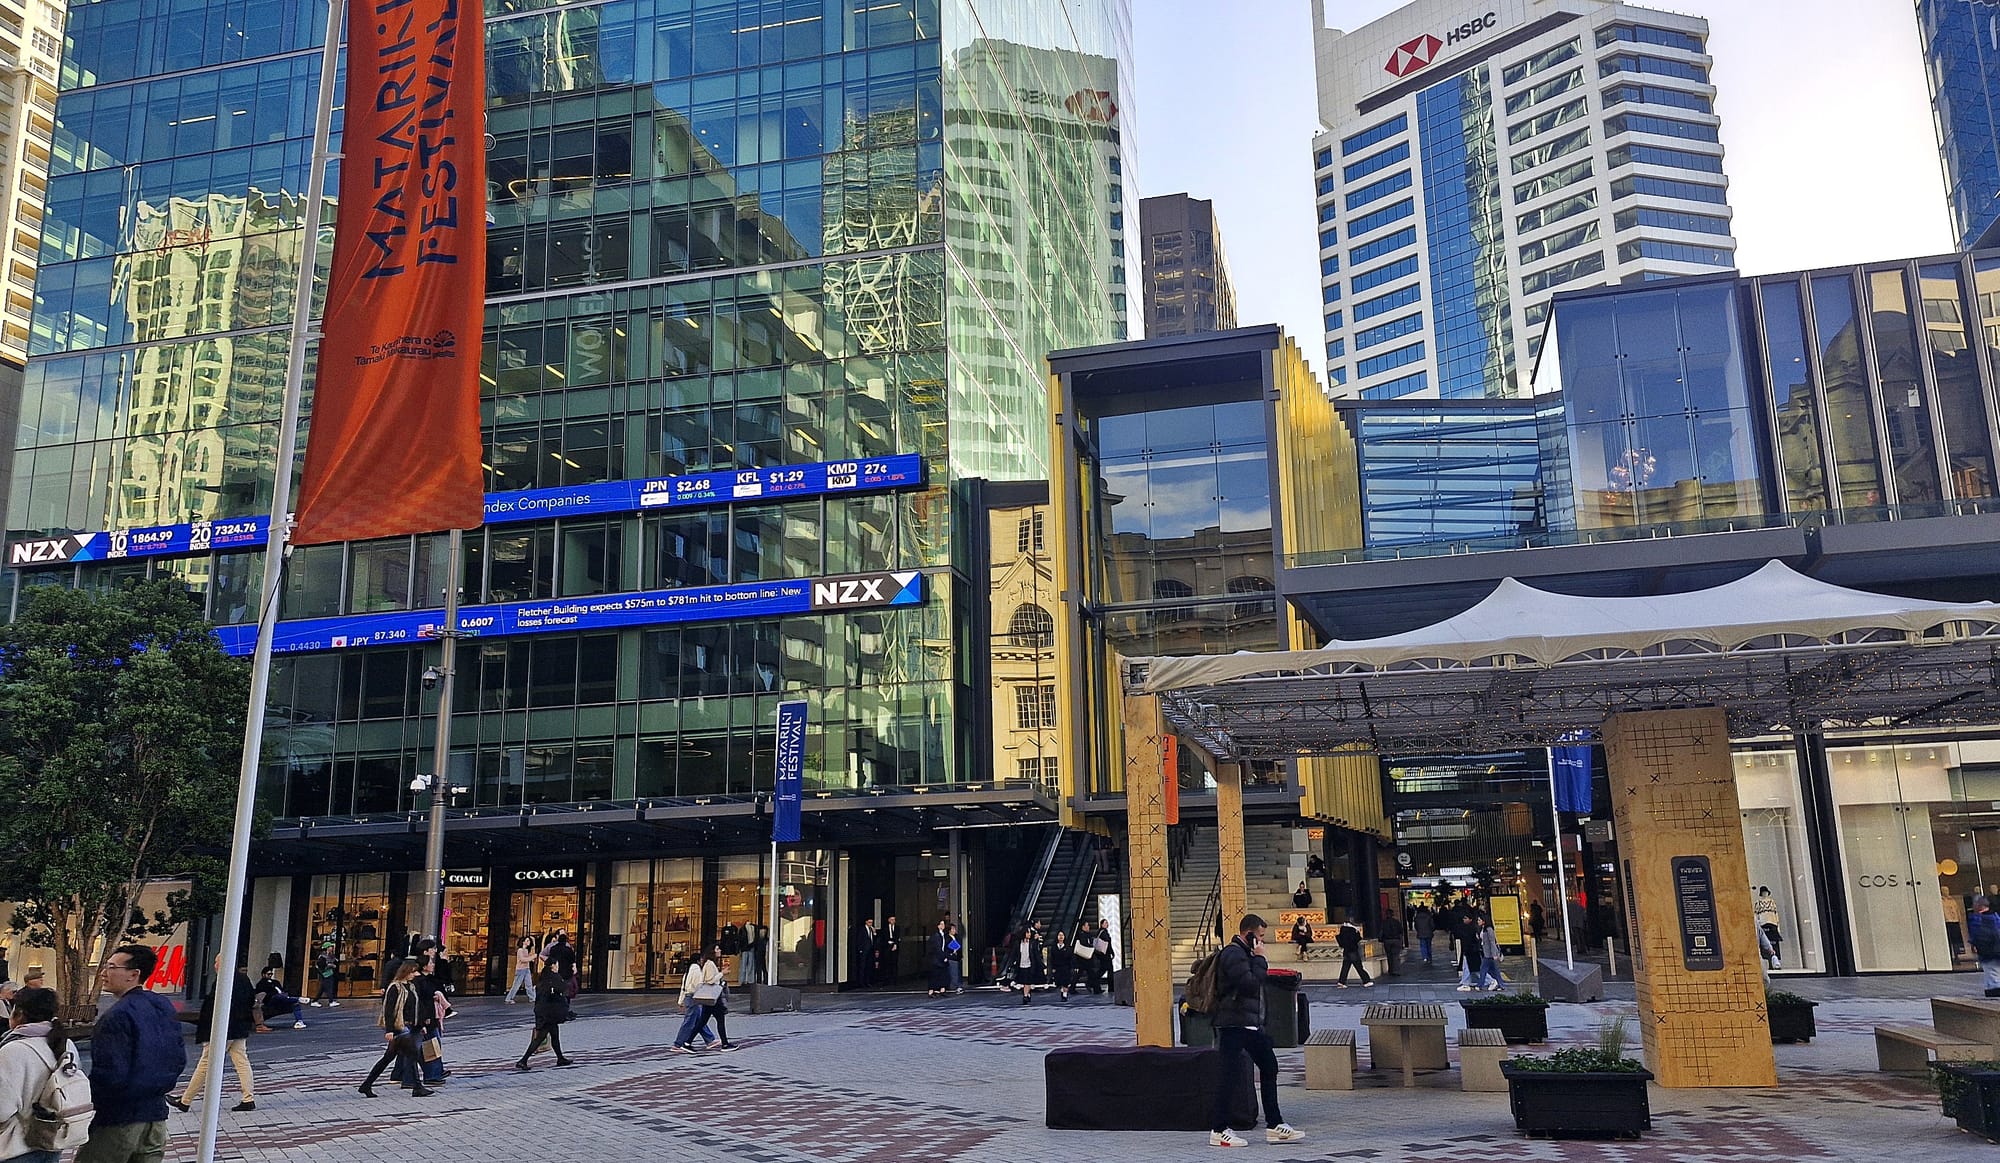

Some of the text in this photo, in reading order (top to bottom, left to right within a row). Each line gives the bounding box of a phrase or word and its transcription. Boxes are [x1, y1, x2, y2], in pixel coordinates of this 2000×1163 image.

[1446, 12, 1496, 46] HSBC
[424, 337, 432, 345] o
[827, 462, 888, 475] KMD 27¢
[737, 470, 804, 484] KFL $1.29
[832, 476, 851, 485] KMD
[643, 479, 710, 492] JPN $2.68
[483, 493, 591, 513] ndex Companies
[190, 528, 212, 543] 20
[215, 522, 257, 536] 7324.76
[111, 535, 128, 551] 10
[132, 530, 173, 544] 1864.99
[12, 539, 69, 564] NZX
[190, 542, 210, 551] INDEX
[107, 550, 127, 559] INDEX
[815, 578, 886, 606] NZX
[518, 586, 802, 617] Fletcher Building expects $575m to $781m hit to bottom line: New
[461, 616, 494, 628] 0.6007
[517, 615, 578, 627] losses forecast
[351, 629, 406, 647] JPY 87.340
[788, 716, 802, 780] FESTIVAL
[449, 874, 483, 883] COACH
[515, 868, 574, 881] COACH
[1859, 875, 1898, 887] COS
